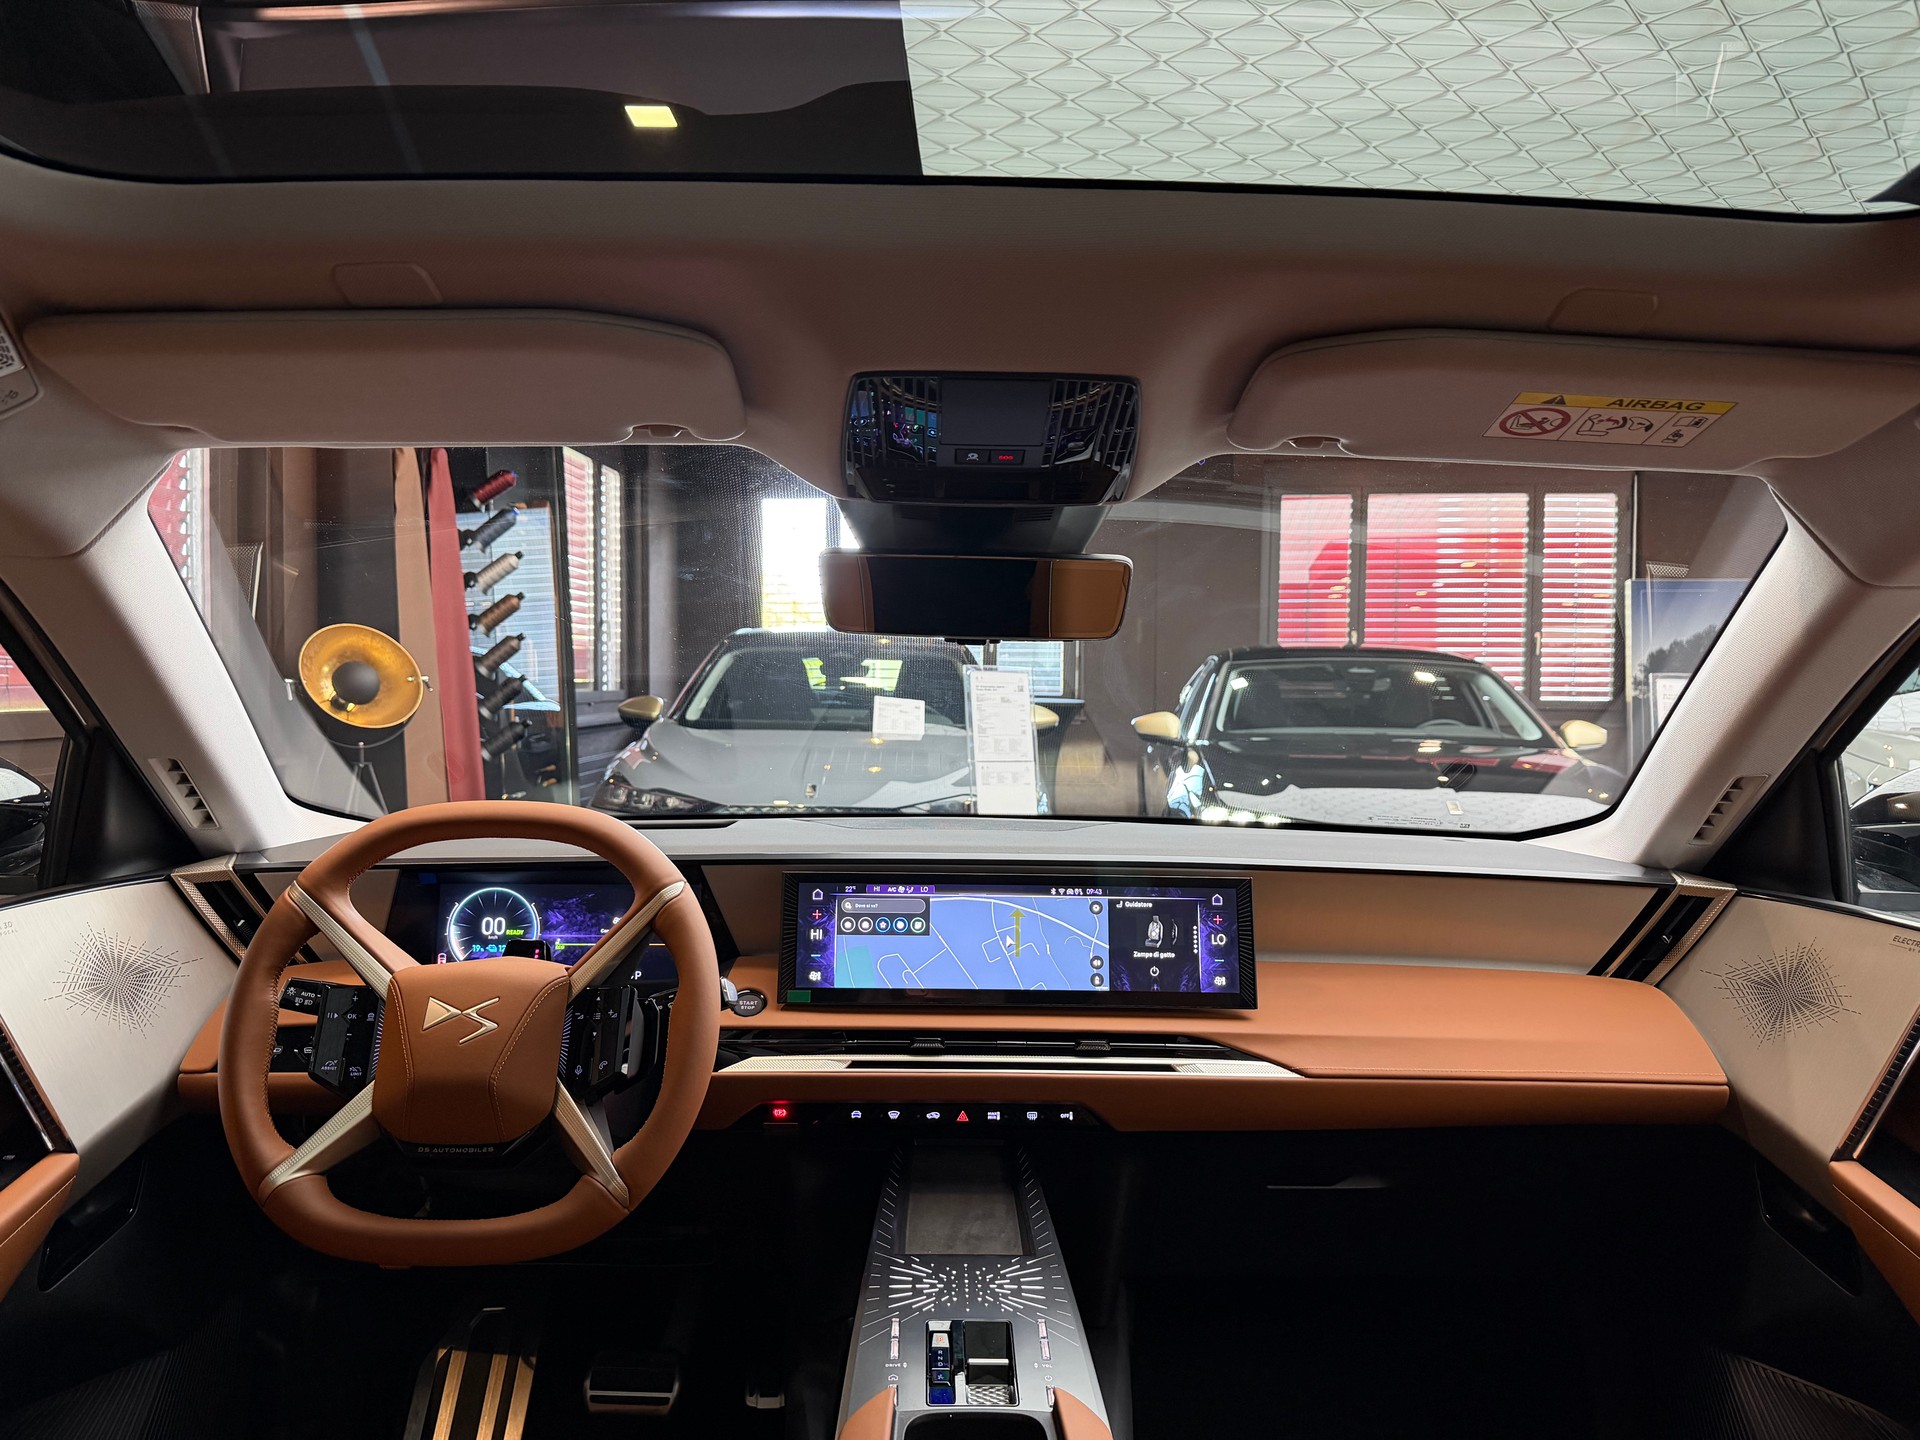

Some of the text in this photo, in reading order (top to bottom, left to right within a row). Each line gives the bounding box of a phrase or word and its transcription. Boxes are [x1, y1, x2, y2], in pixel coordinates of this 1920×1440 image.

[1606, 398, 1706, 411] AIRBAG
[481, 916, 506, 936] 00
[810, 929, 823, 941] HI
[1211, 933, 1227, 946] LO
[634, 970, 642, 980] P
[422, 996, 500, 1044] DS
